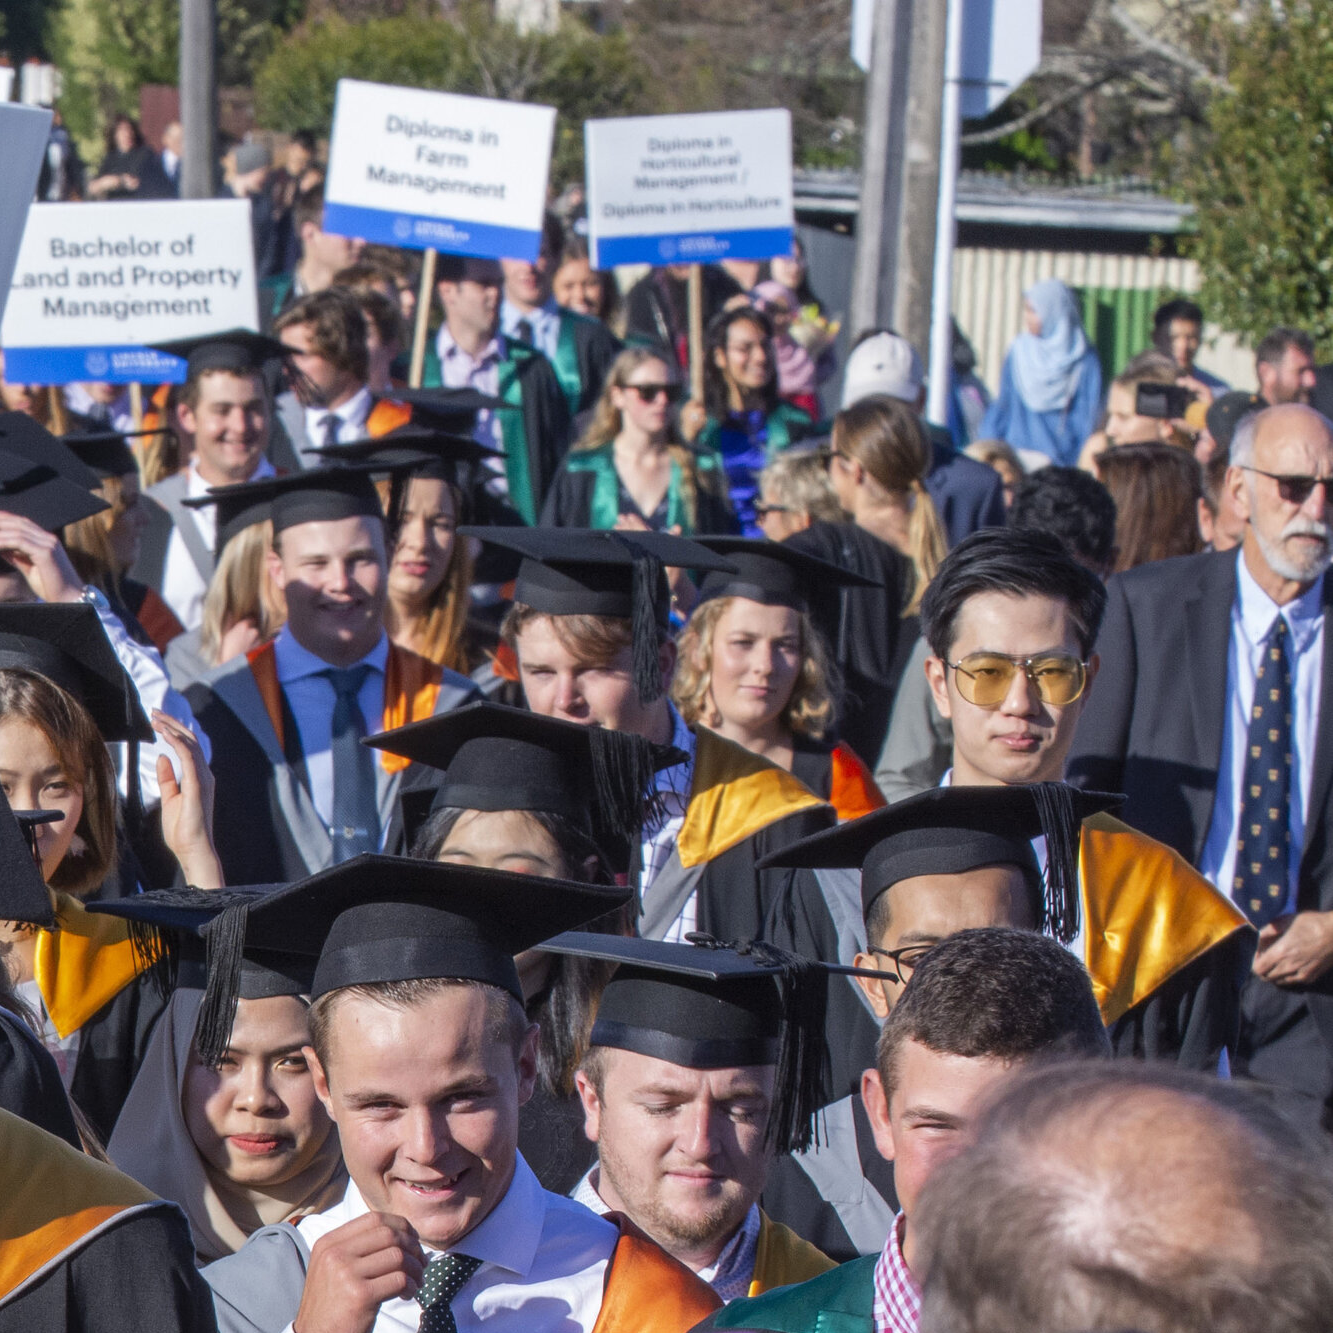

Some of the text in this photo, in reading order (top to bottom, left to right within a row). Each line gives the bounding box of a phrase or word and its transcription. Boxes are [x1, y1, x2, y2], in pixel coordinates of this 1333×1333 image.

[385, 114, 499, 146] Diploma in
[416, 145, 469, 168] Farm
[366, 164, 506, 199] Management
[50, 234, 195, 258] Bachelor of
[77, 265, 124, 288] and
[132, 265, 242, 289] Property
[42, 297, 213, 320] Management
